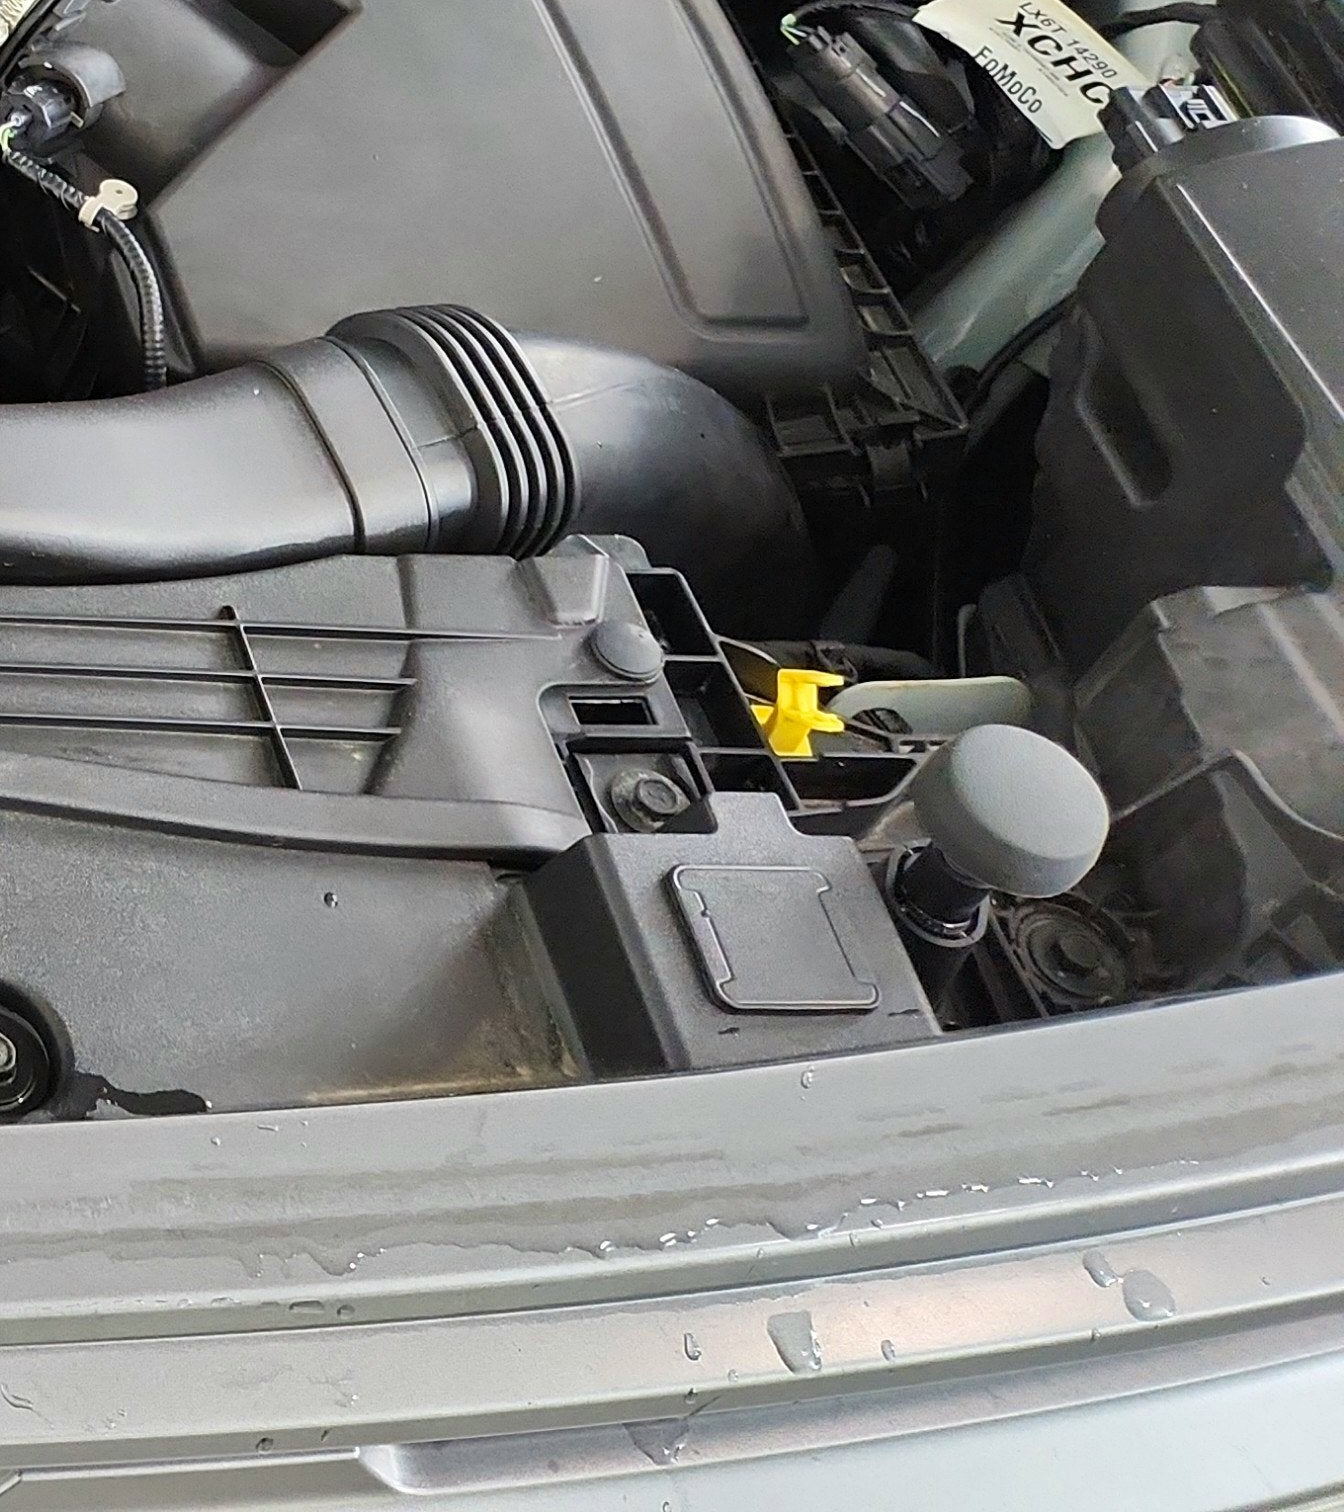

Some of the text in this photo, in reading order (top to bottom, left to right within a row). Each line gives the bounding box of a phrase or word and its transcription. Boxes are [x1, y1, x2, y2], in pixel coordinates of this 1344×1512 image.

[1018, 1, 1068, 34] LX6T
[1067, 39, 1118, 80] 14290
[974, 45, 1043, 114] FoMoCo
